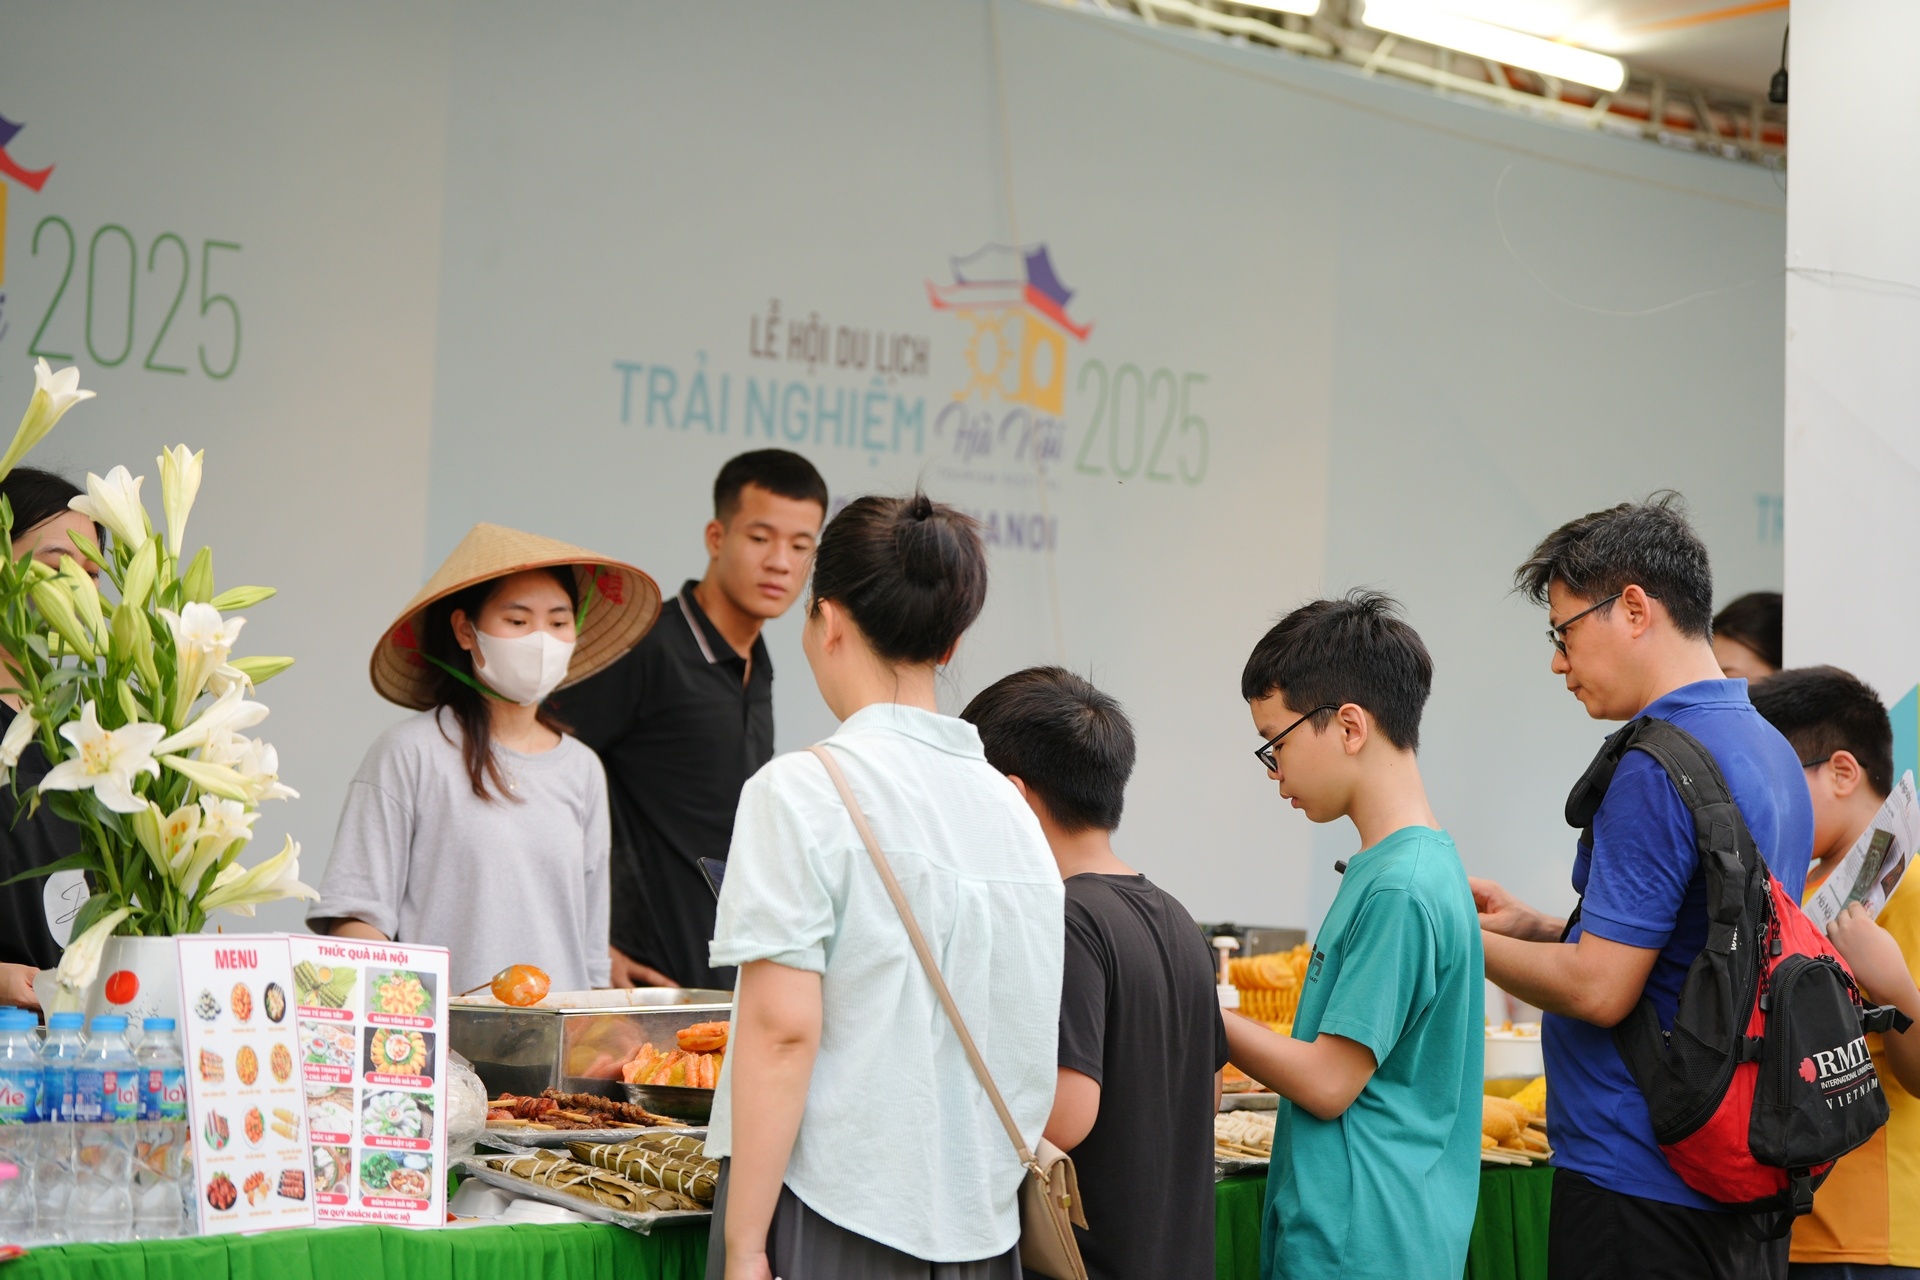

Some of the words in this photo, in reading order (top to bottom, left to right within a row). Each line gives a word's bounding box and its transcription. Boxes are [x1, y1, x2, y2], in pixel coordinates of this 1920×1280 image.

[27, 214, 242, 380] 2025
[749, 298, 782, 360] LỄ
[786, 311, 830, 375] HỘI
[836, 324, 870, 370] DU
[875, 330, 931, 386] LỊCH
[612, 349, 731, 436] TRẢI
[743, 375, 926, 468] NGHIỆM
[933, 401, 994, 464] Hà
[1074, 357, 1211, 486] 2025
[970, 505, 1058, 554] ANOI
[215, 949, 258, 970] MENU
[318, 944, 346, 958] THỨC
[348, 947, 370, 960] QUÀ
[373, 949, 388, 962] HÀ
[390, 952, 409, 966] NỘI
[1820, 1071, 1858, 1090] INTERNATIONAL
[1826, 1078, 1878, 1110] VIETNAM
